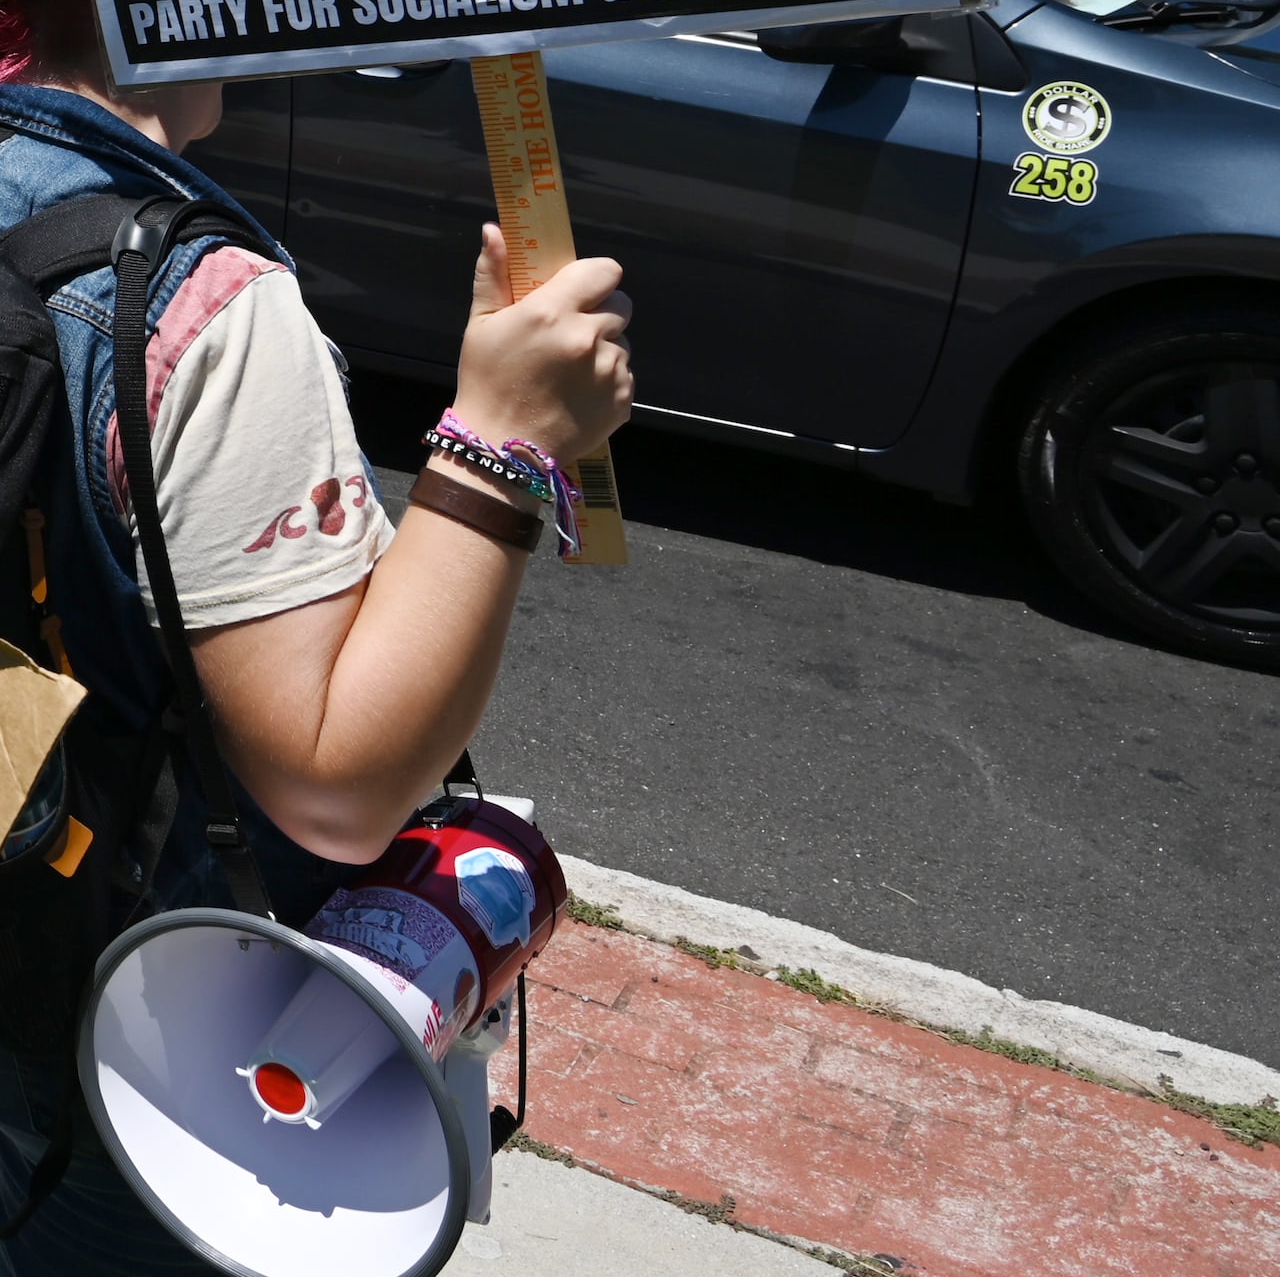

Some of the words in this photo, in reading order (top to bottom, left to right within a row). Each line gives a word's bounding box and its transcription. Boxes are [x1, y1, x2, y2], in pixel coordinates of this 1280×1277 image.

[1043, 85, 1099, 105] DOLLAR
[1054, 138, 1094, 151] SHARE
[525, 137, 557, 196] THE
[1011, 153, 1097, 204] 258
[430, 435, 504, 474] DEFEND
